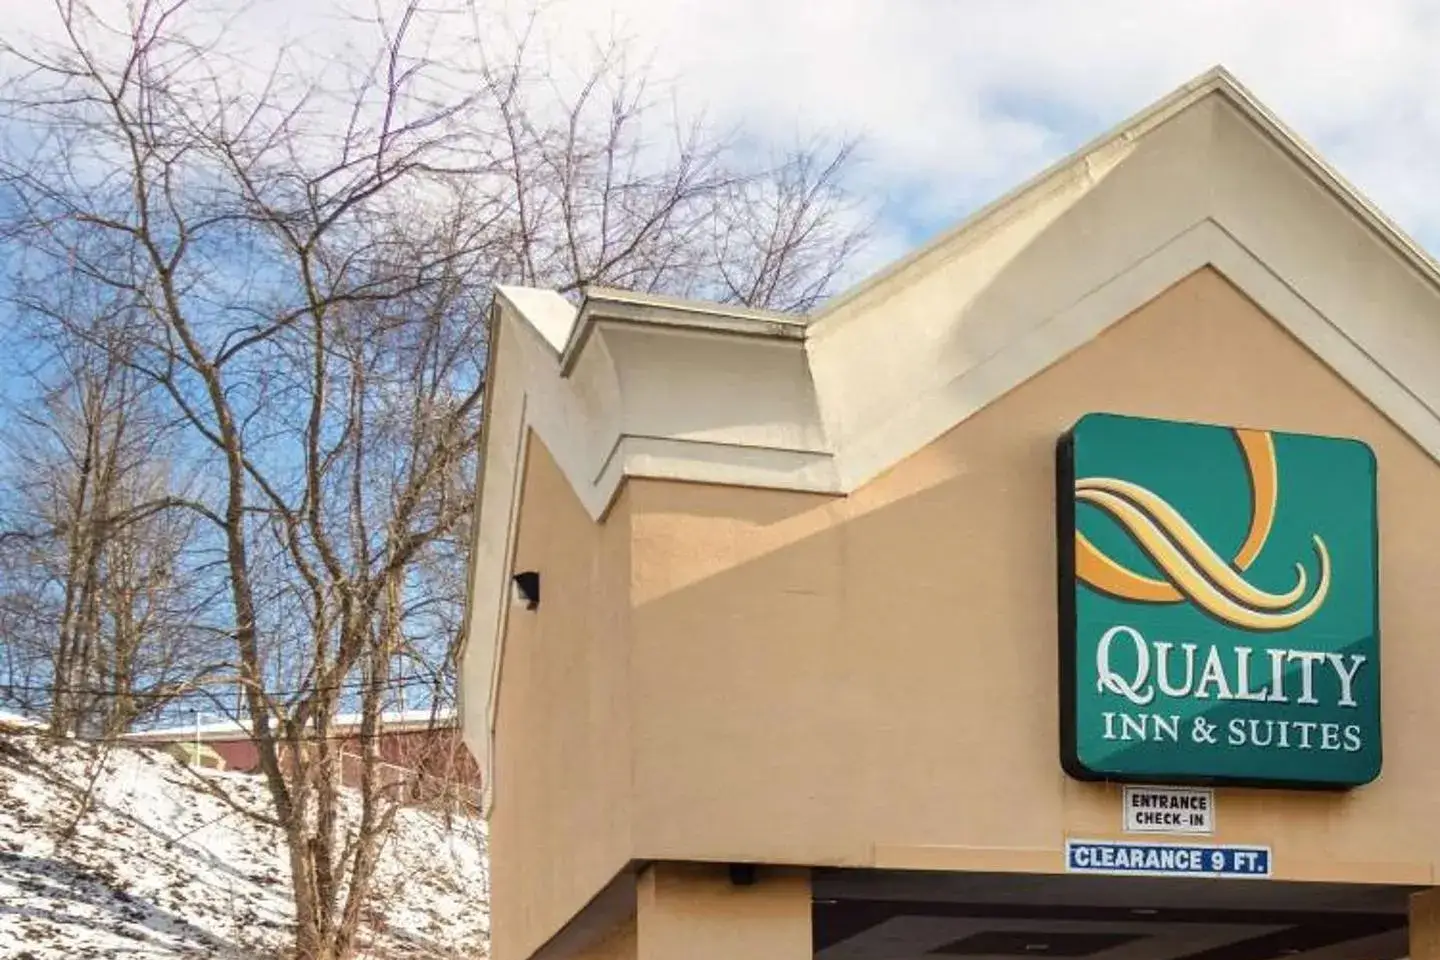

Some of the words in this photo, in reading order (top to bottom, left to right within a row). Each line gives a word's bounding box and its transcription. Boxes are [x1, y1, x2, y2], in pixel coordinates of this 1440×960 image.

[1096, 625, 1366, 706] QUALITY
[1101, 712, 1180, 741] INN
[1191, 716, 1217, 744] &
[1228, 718, 1361, 751] SUITES
[1132, 794, 1207, 810] ENTRANCE
[1136, 811, 1204, 826] CHECK-IN
[1074, 846, 1203, 869] CLEARANCE
[1211, 851, 1225, 869] 9
[1234, 852, 1265, 872] FT.
